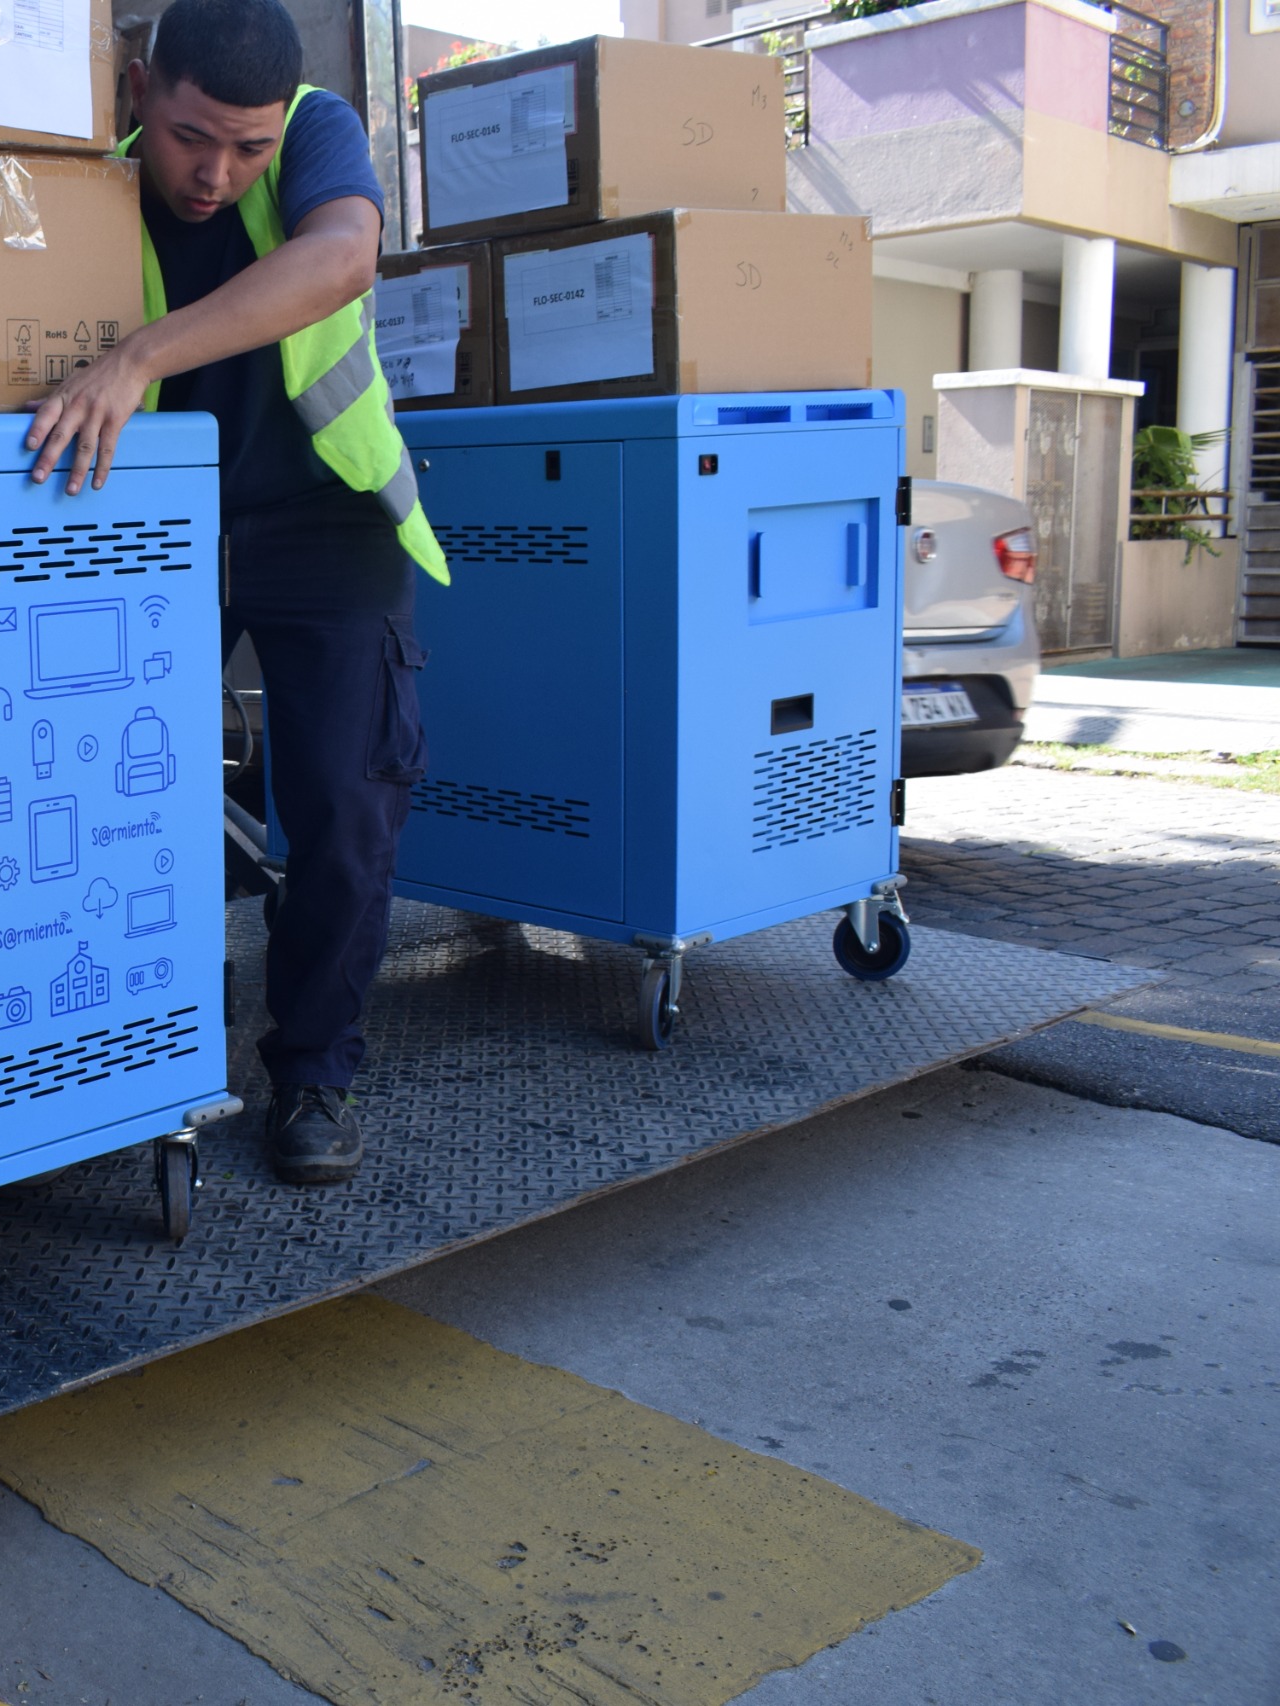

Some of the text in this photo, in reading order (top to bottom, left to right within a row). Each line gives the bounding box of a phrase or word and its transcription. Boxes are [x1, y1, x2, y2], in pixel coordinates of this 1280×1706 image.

[451, 124, 501, 143] FLO-SEC-0145
[681, 117, 714, 147] SD
[735, 261, 762, 290] SD
[533, 288, 585, 306] FLO-SEC-0142
[45, 330, 68, 339] RoHS
[100, 323, 116, 338] 10
[17, 344, 32, 353] FSC
[91, 818, 156, 848] S@rmiento
